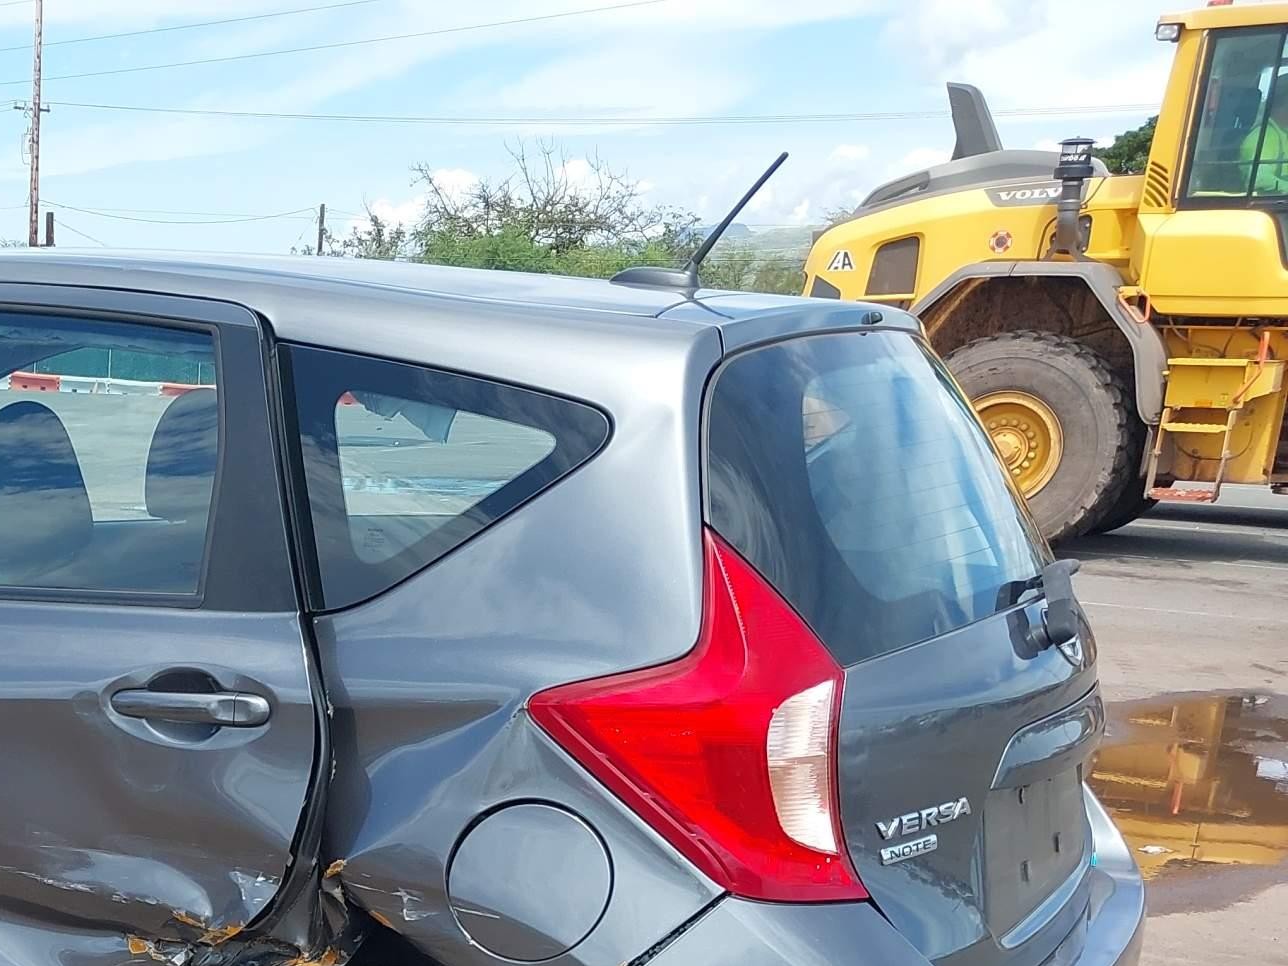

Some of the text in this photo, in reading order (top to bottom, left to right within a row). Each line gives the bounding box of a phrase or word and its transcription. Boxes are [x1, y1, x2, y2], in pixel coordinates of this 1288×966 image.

[997, 187, 1063, 201] VOLV
[874, 797, 972, 841] VERSA
[888, 839, 934, 861] NOTE
